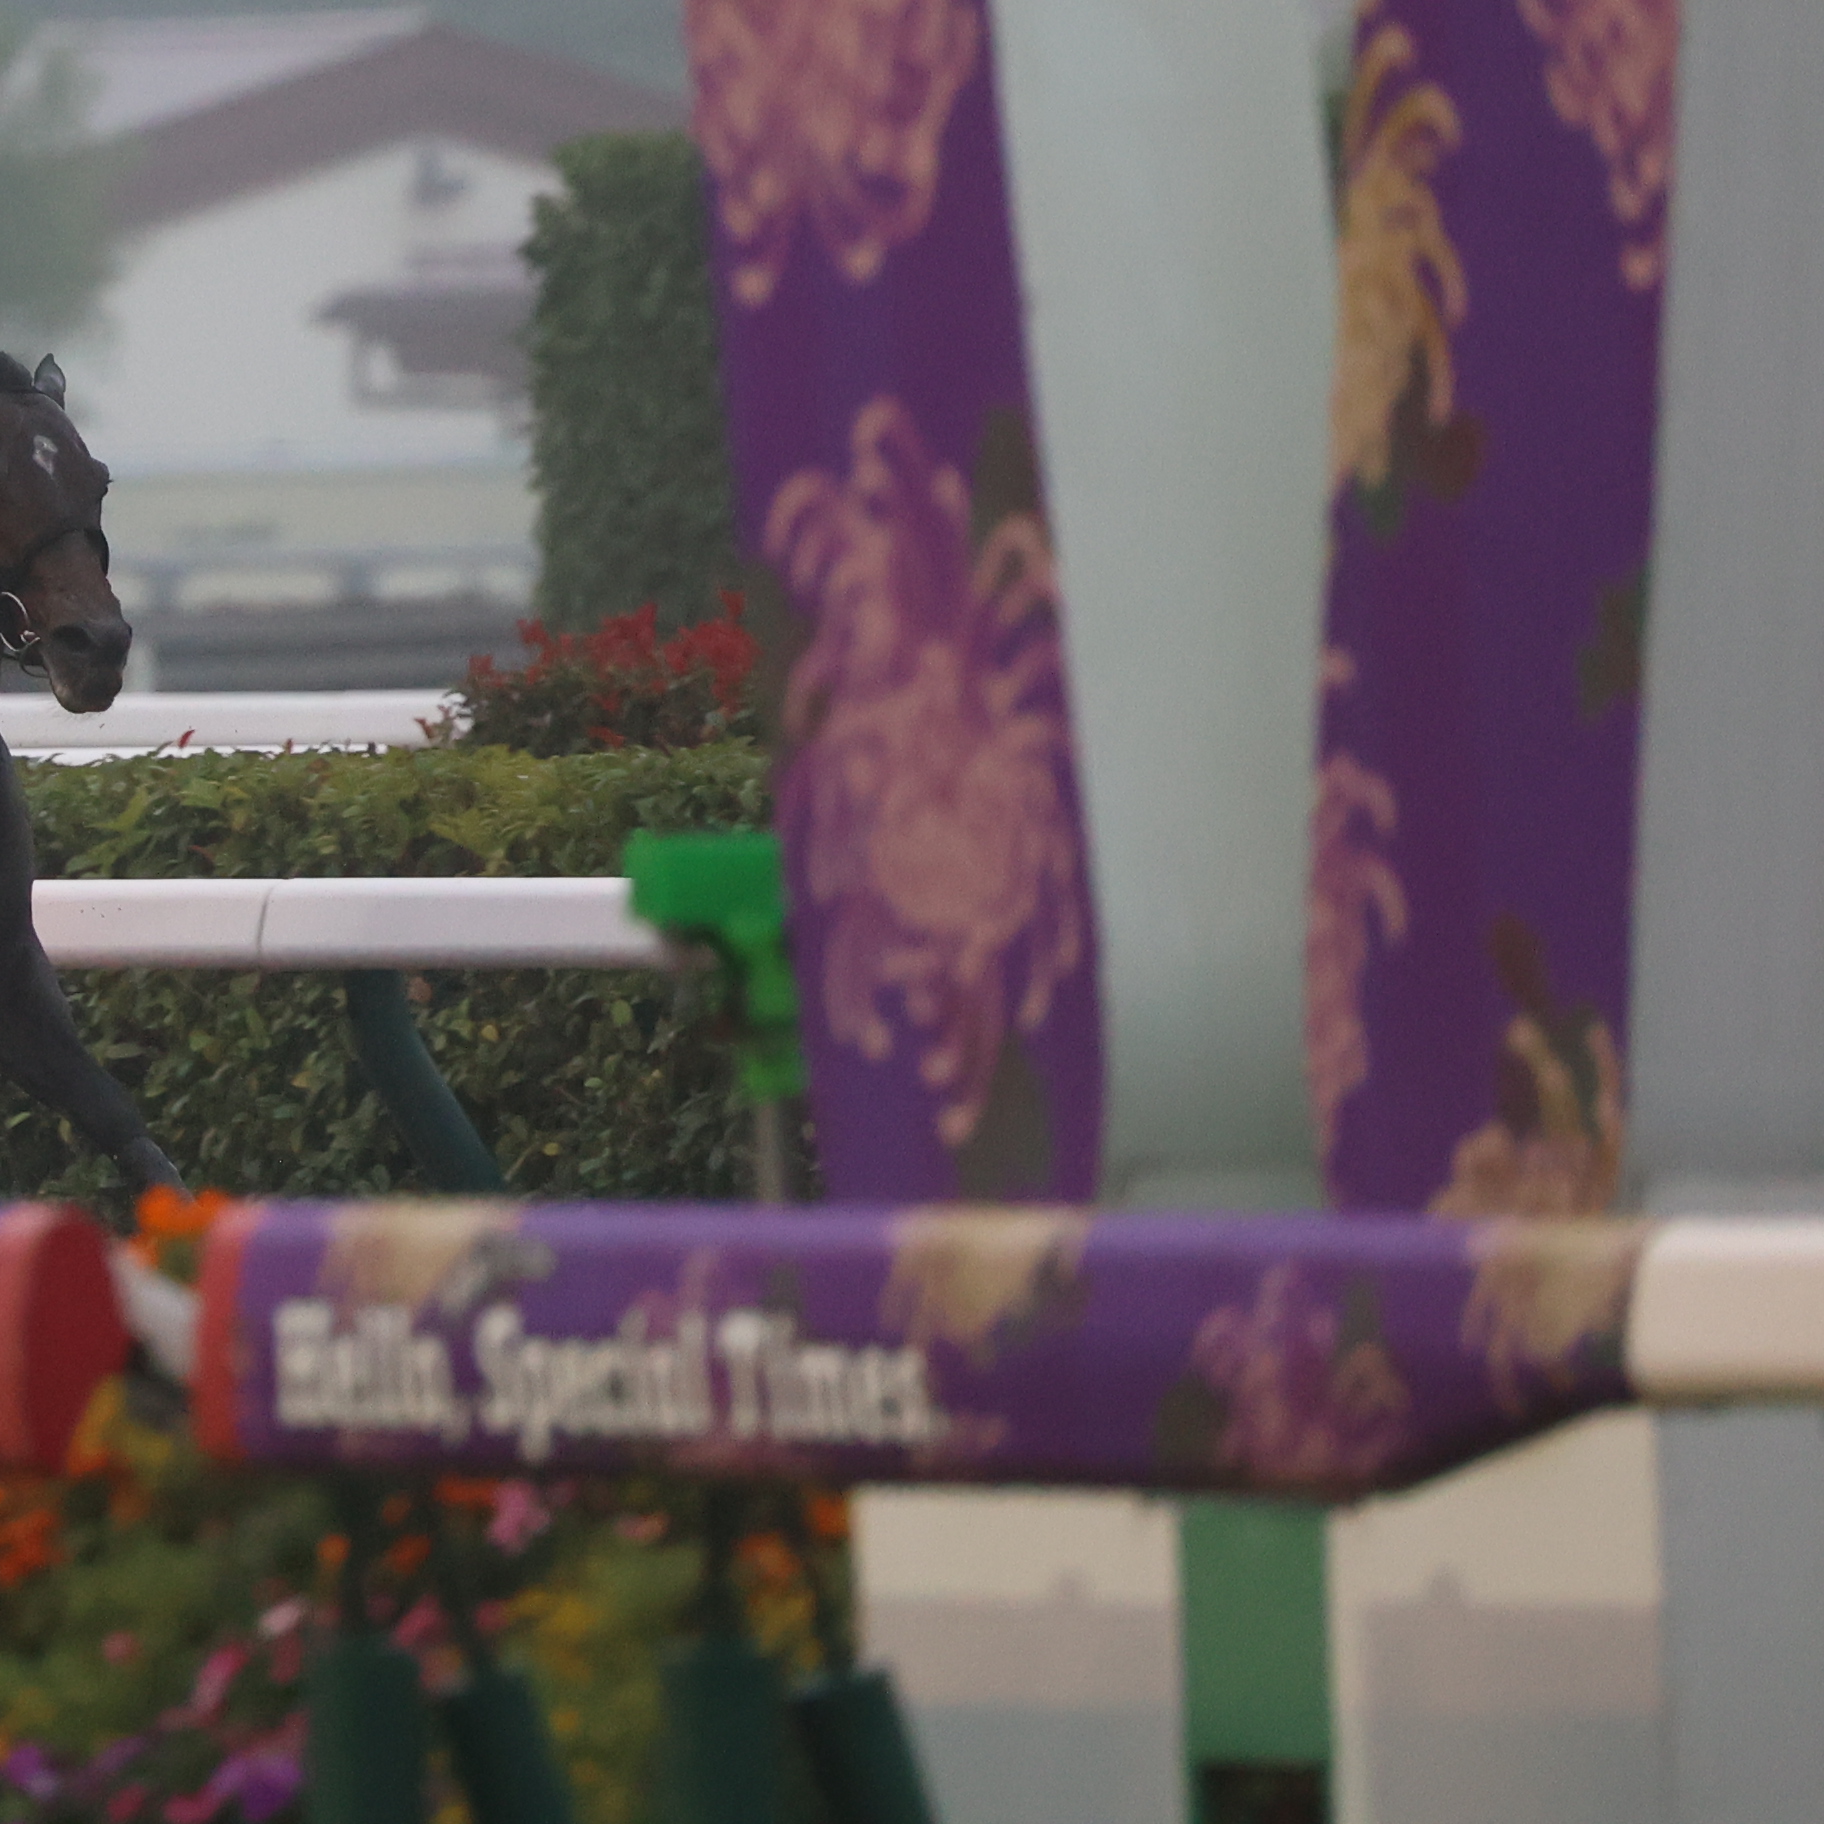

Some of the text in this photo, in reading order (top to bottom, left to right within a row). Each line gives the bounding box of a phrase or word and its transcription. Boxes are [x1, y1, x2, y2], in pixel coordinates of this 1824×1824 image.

[274, 1301, 949, 1461] Hello, Special Times.
